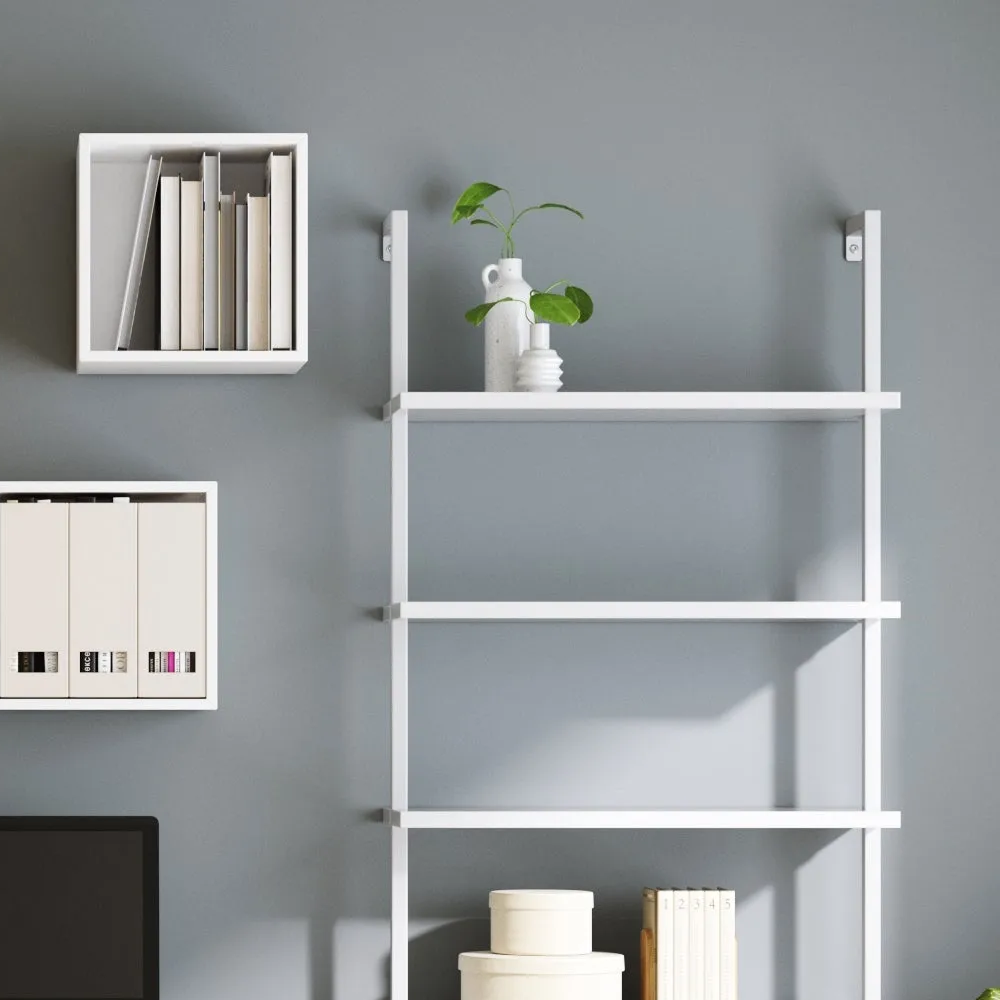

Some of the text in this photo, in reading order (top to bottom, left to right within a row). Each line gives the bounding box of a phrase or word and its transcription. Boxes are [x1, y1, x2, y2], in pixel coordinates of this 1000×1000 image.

[678, 898, 685, 910] 2
[693, 898, 700, 910] 3
[708, 898, 716, 910] 4
[724, 898, 731, 910] 5
